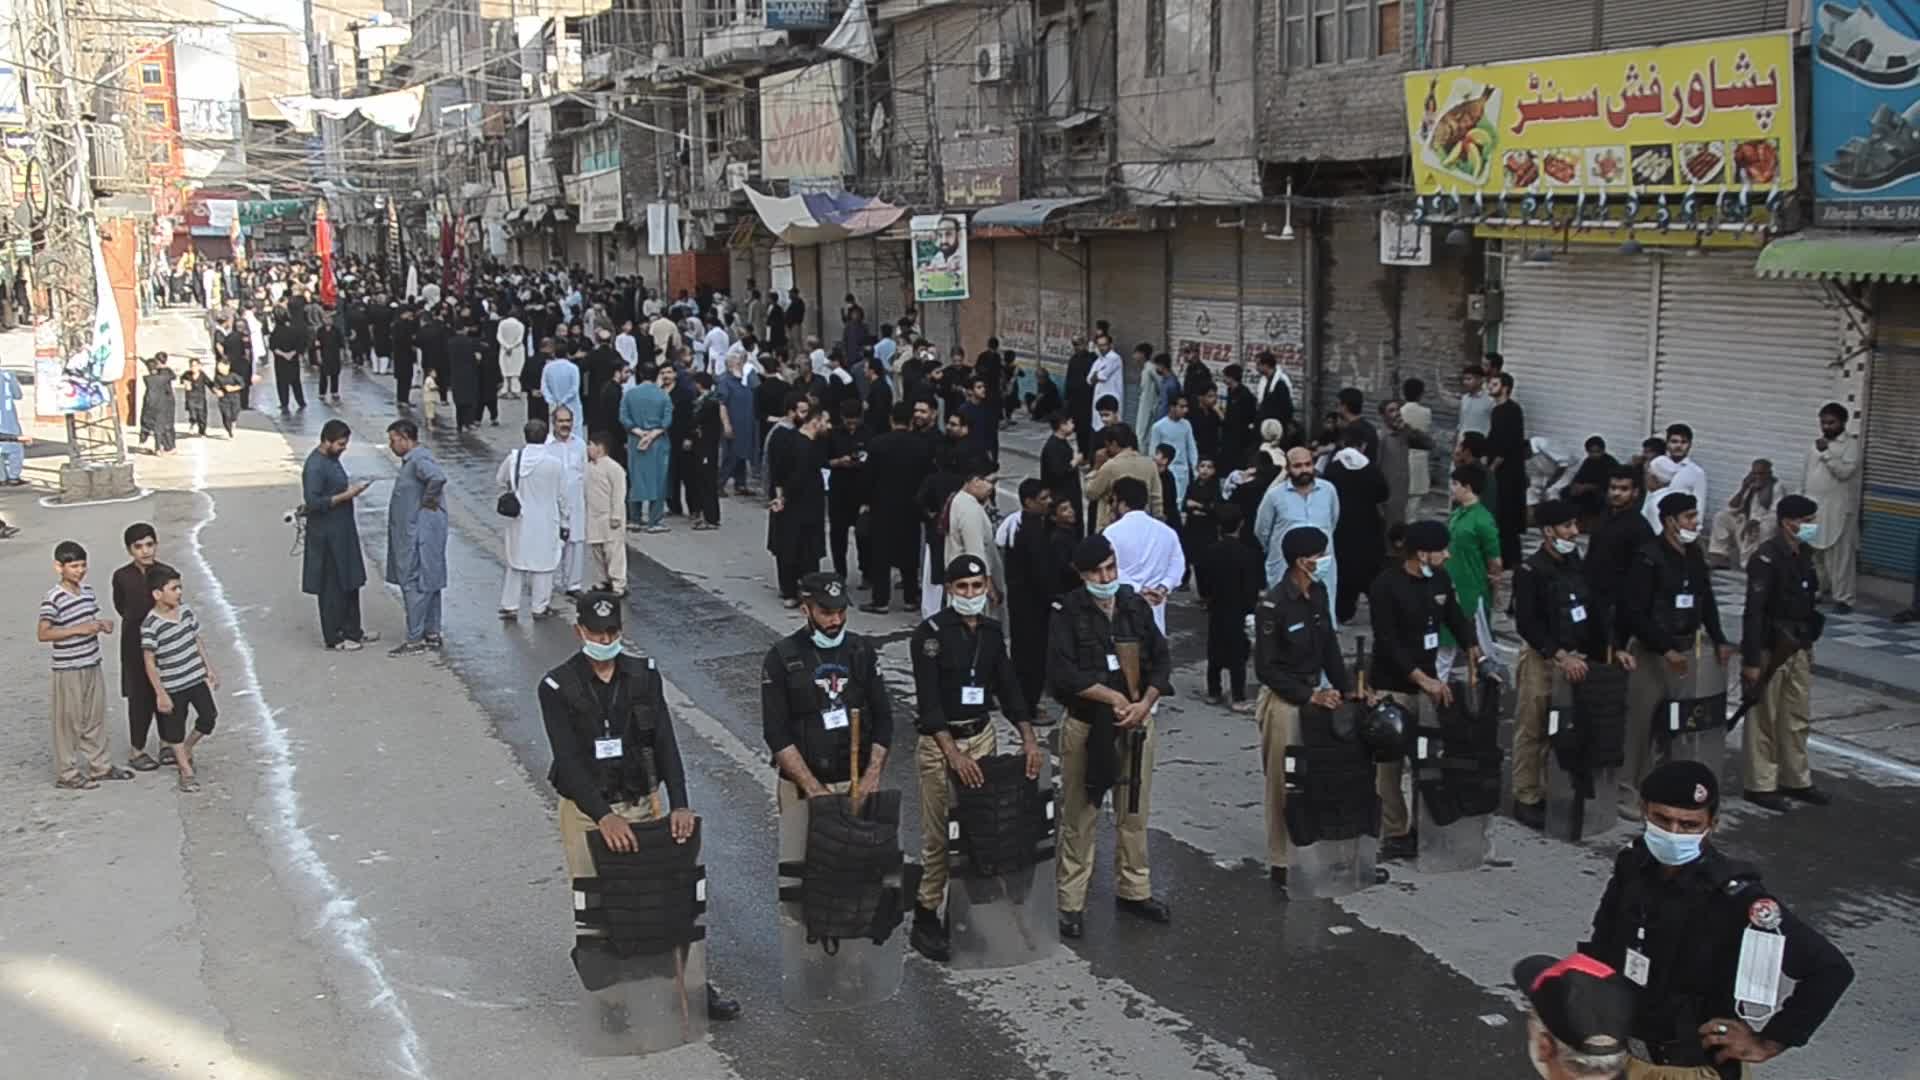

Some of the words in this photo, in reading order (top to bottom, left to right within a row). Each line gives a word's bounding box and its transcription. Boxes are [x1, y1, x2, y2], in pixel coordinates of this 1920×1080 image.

[1510, 72, 1599, 134] سنٹر
[1605, 64, 1664, 128] فش
[1665, 52, 1779, 129] پشاور
